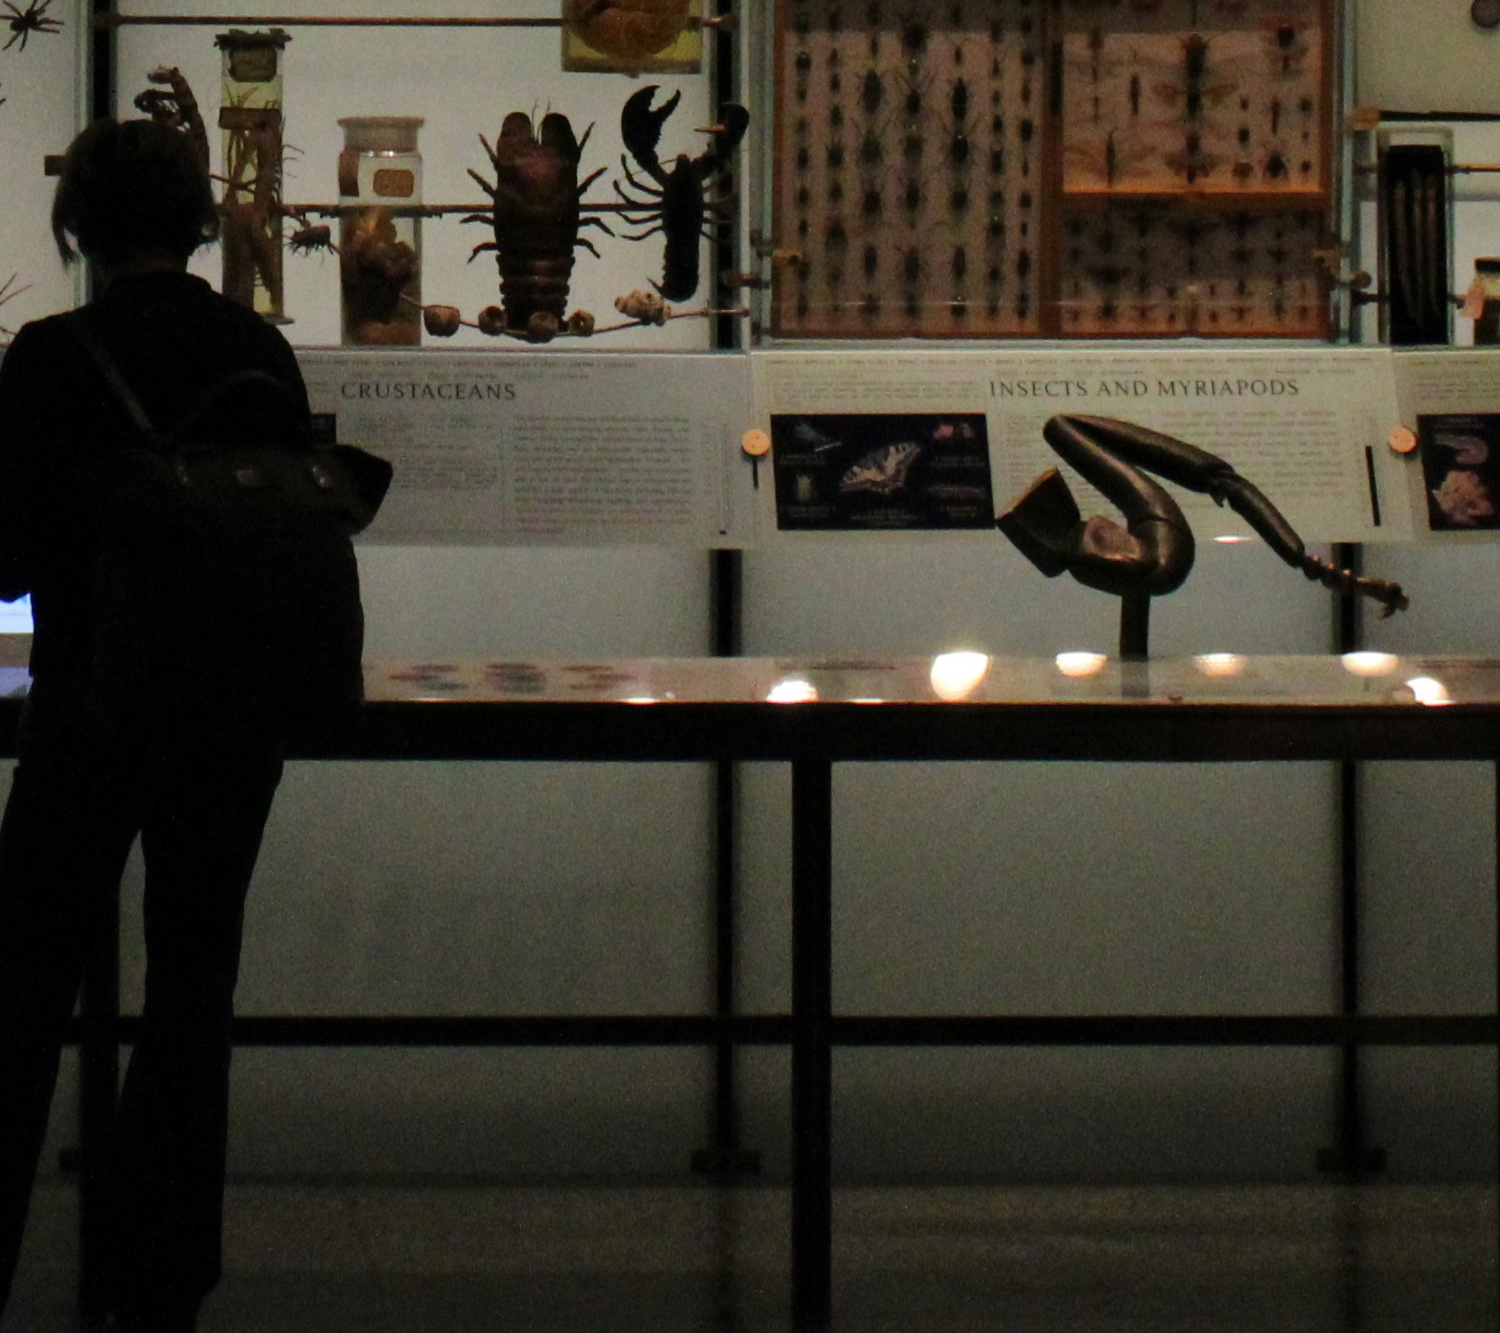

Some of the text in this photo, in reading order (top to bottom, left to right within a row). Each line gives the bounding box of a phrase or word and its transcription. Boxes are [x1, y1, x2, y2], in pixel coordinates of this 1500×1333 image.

[341, 381, 516, 400] CRUSTACEANS
[989, 378, 1089, 399] INSECTS
[1096, 378, 1149, 398] AND
[1157, 377, 1301, 398] MYRIAPODS
